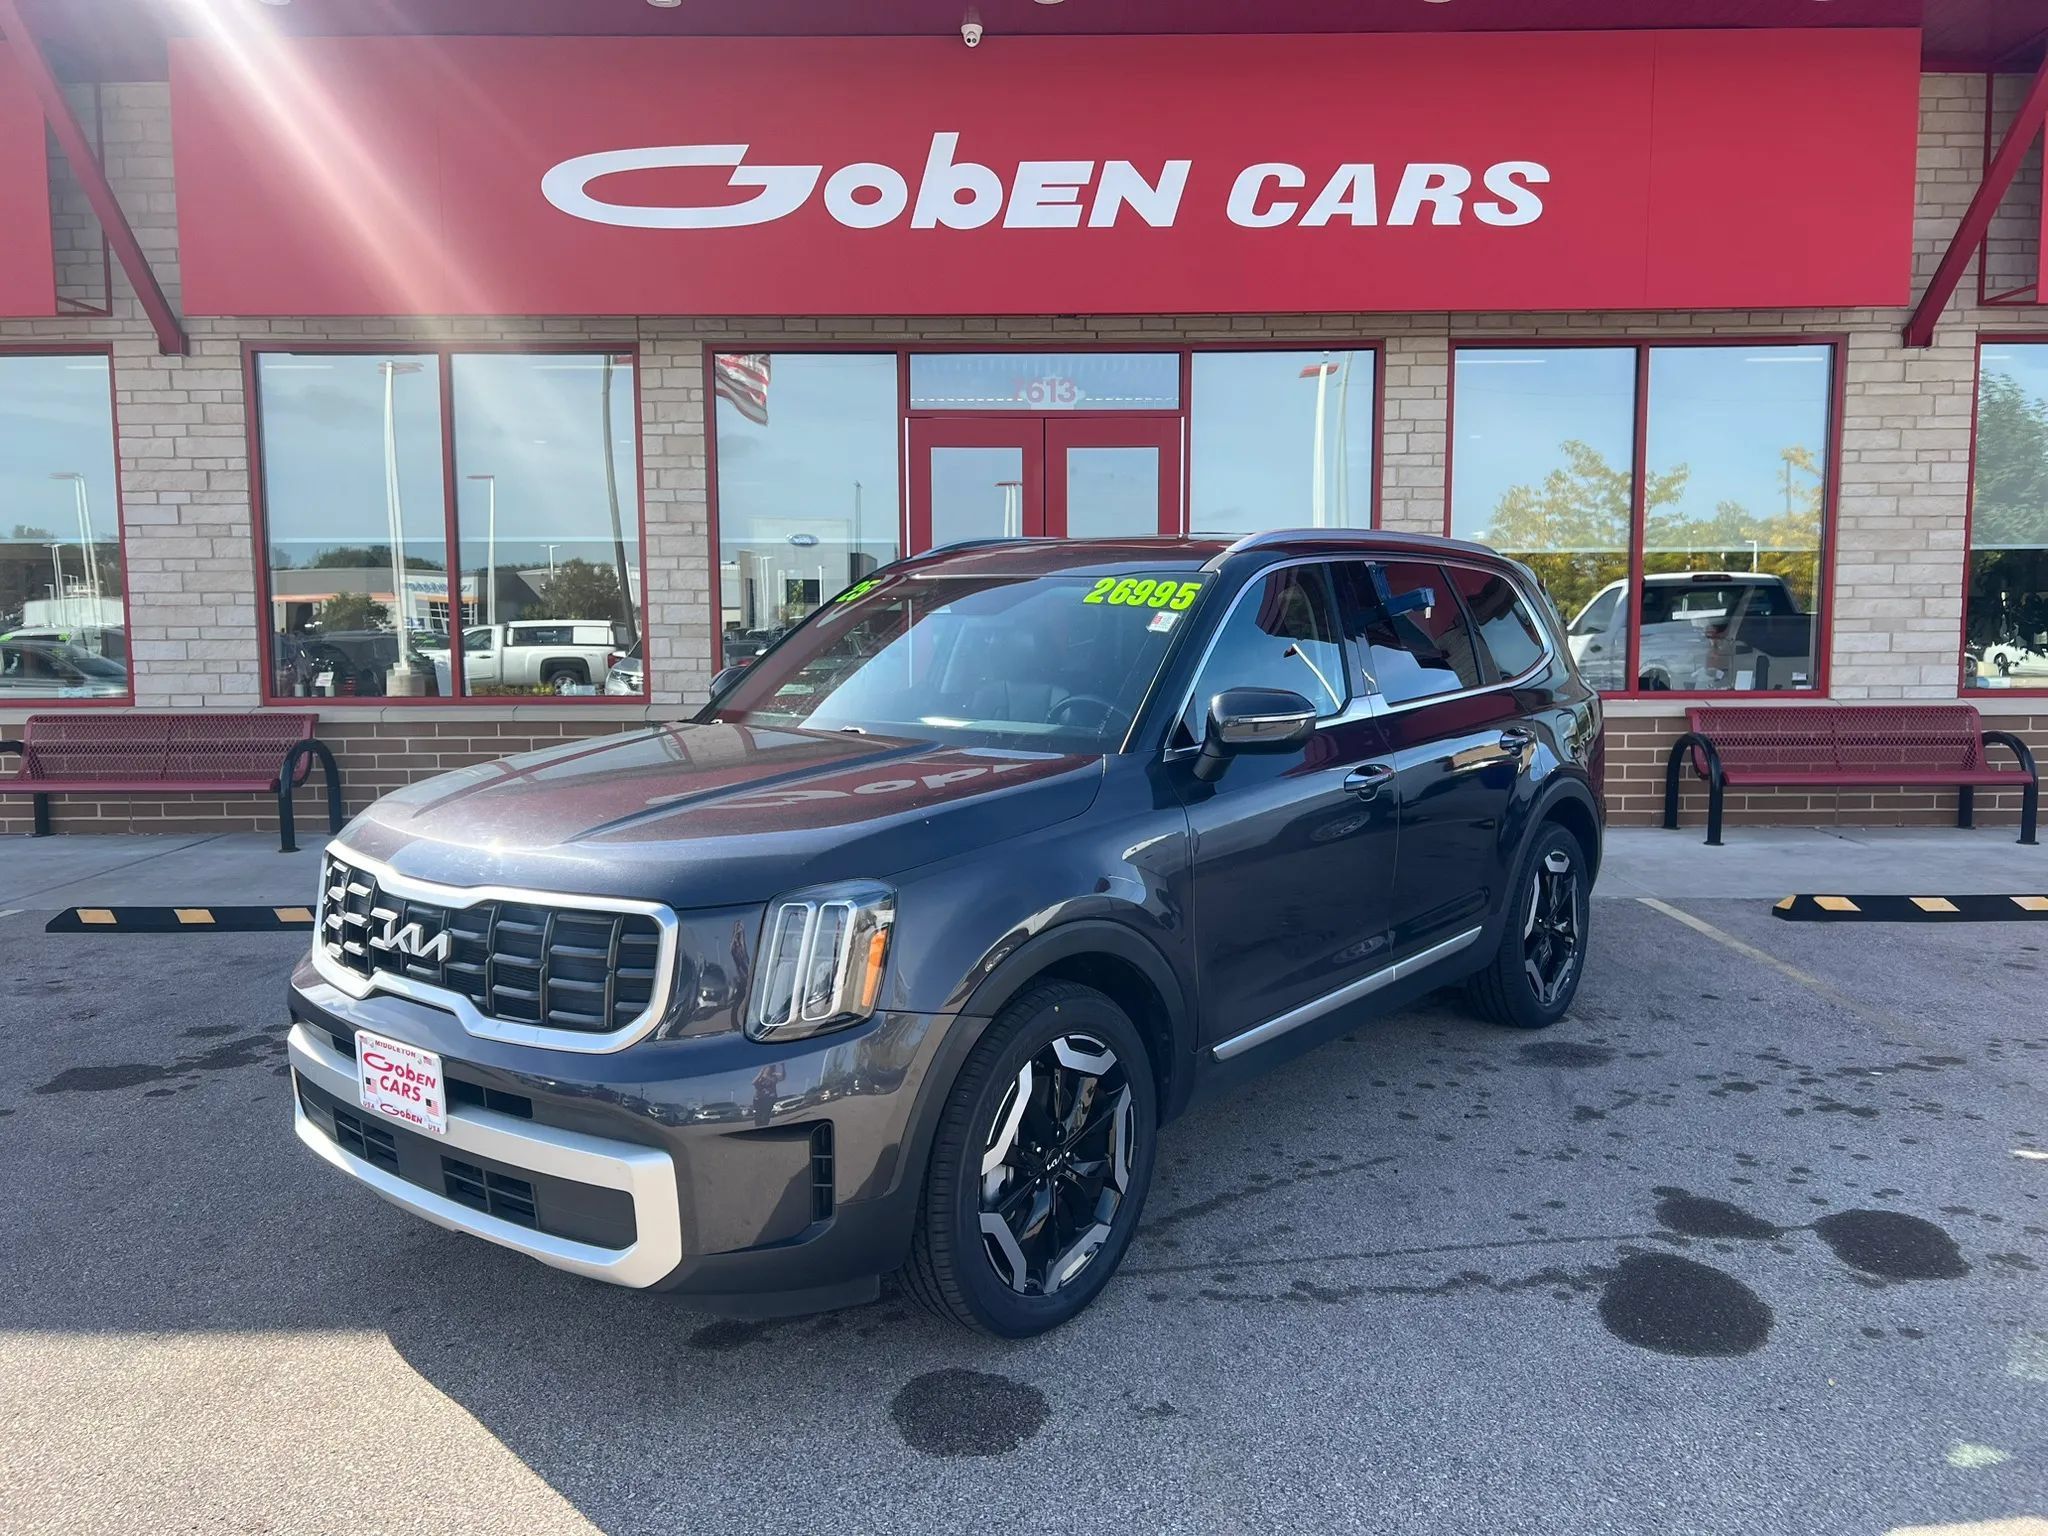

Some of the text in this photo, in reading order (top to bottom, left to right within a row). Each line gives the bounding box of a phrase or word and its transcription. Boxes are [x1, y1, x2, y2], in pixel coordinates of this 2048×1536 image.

[1226, 160, 1551, 227] CARS
[1083, 577, 1202, 610] 26995
[374, 1039, 417, 1058] MIDDLETON
[379, 1075, 421, 1102] CARS
[428, 1123, 441, 1133] USA
